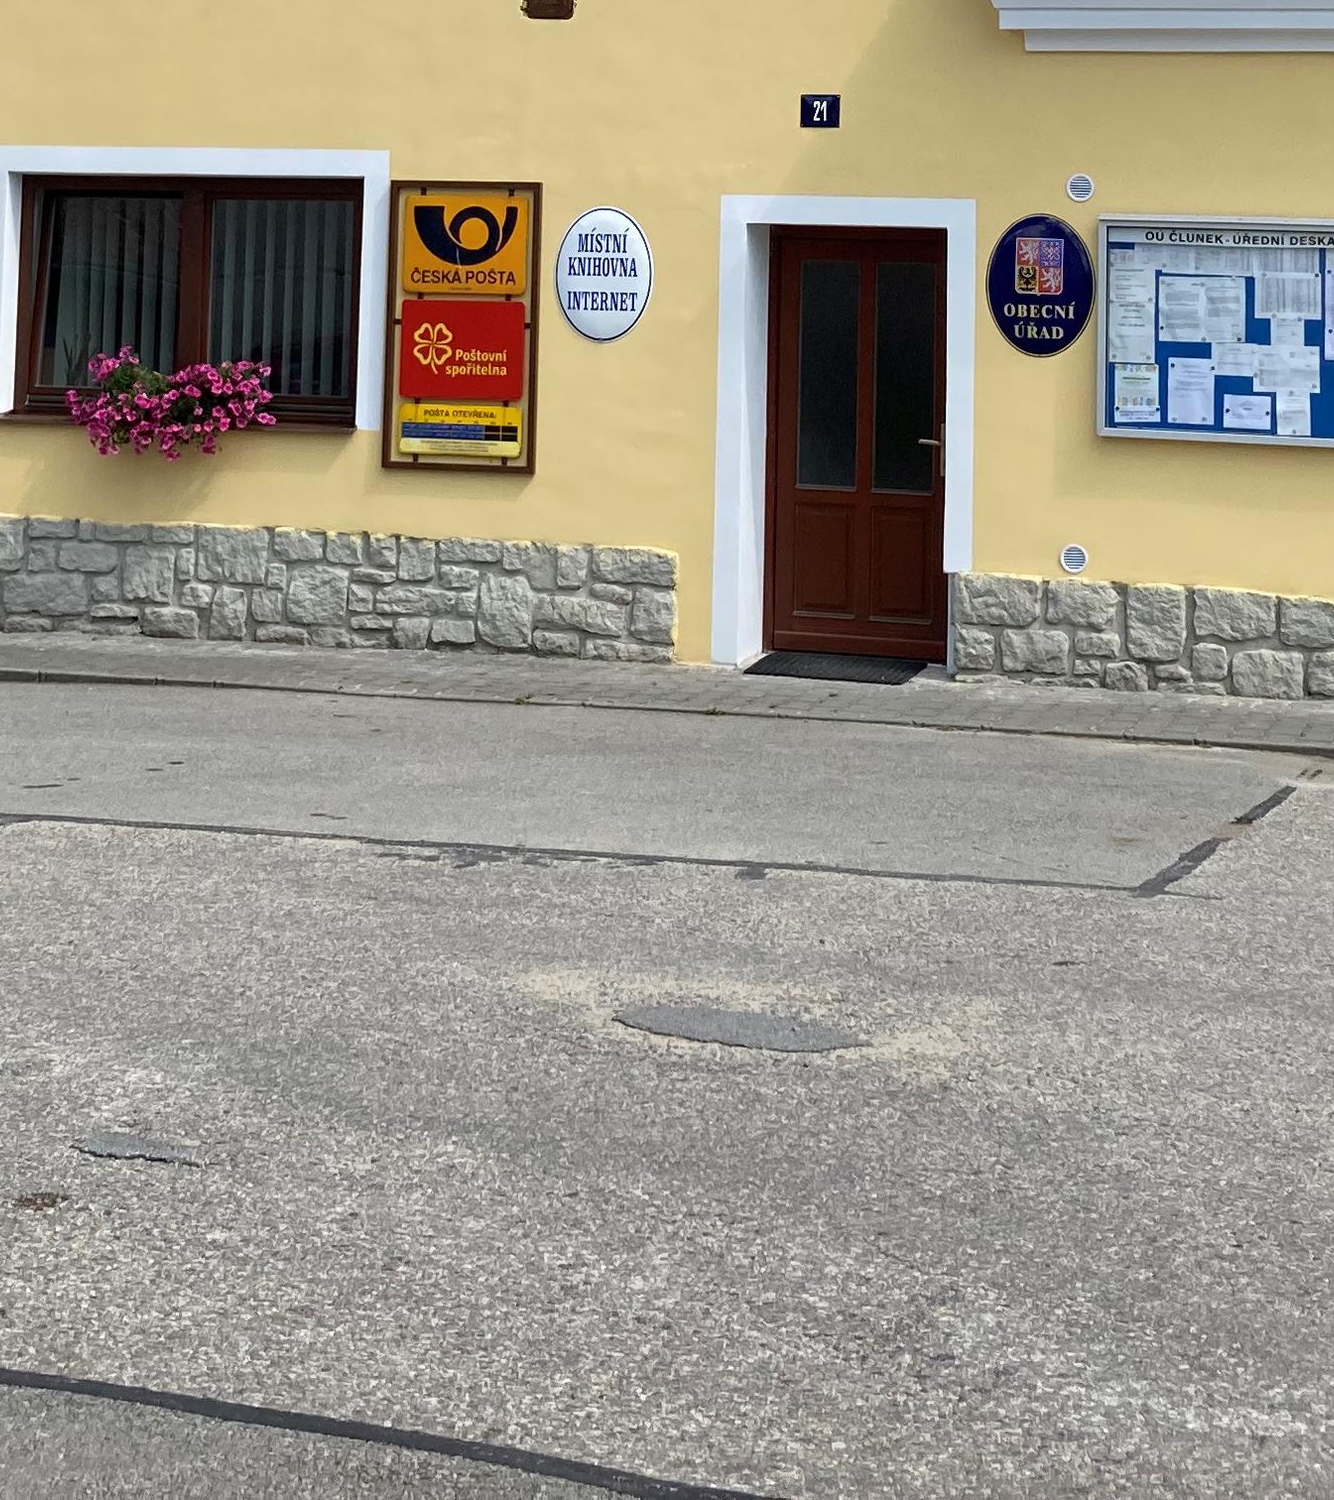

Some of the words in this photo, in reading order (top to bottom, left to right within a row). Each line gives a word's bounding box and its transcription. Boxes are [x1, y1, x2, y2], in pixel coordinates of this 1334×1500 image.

[813, 100, 827, 121] 21
[578, 227, 629, 253] MÍSTNÍ
[1169, 230, 1223, 244] ČLUNEK
[410, 267, 462, 284] ČESKÁ
[466, 268, 516, 285] POŠTA
[568, 257, 638, 277] KNIHOVNA
[567, 291, 638, 312] INTERNET
[1003, 301, 1075, 319] OBECNÍ
[1014, 321, 1064, 339] ÚŘAD
[455, 348, 507, 361] Poštovní
[445, 363, 507, 377] spořitelna
[423, 408, 450, 417] POŠTA
